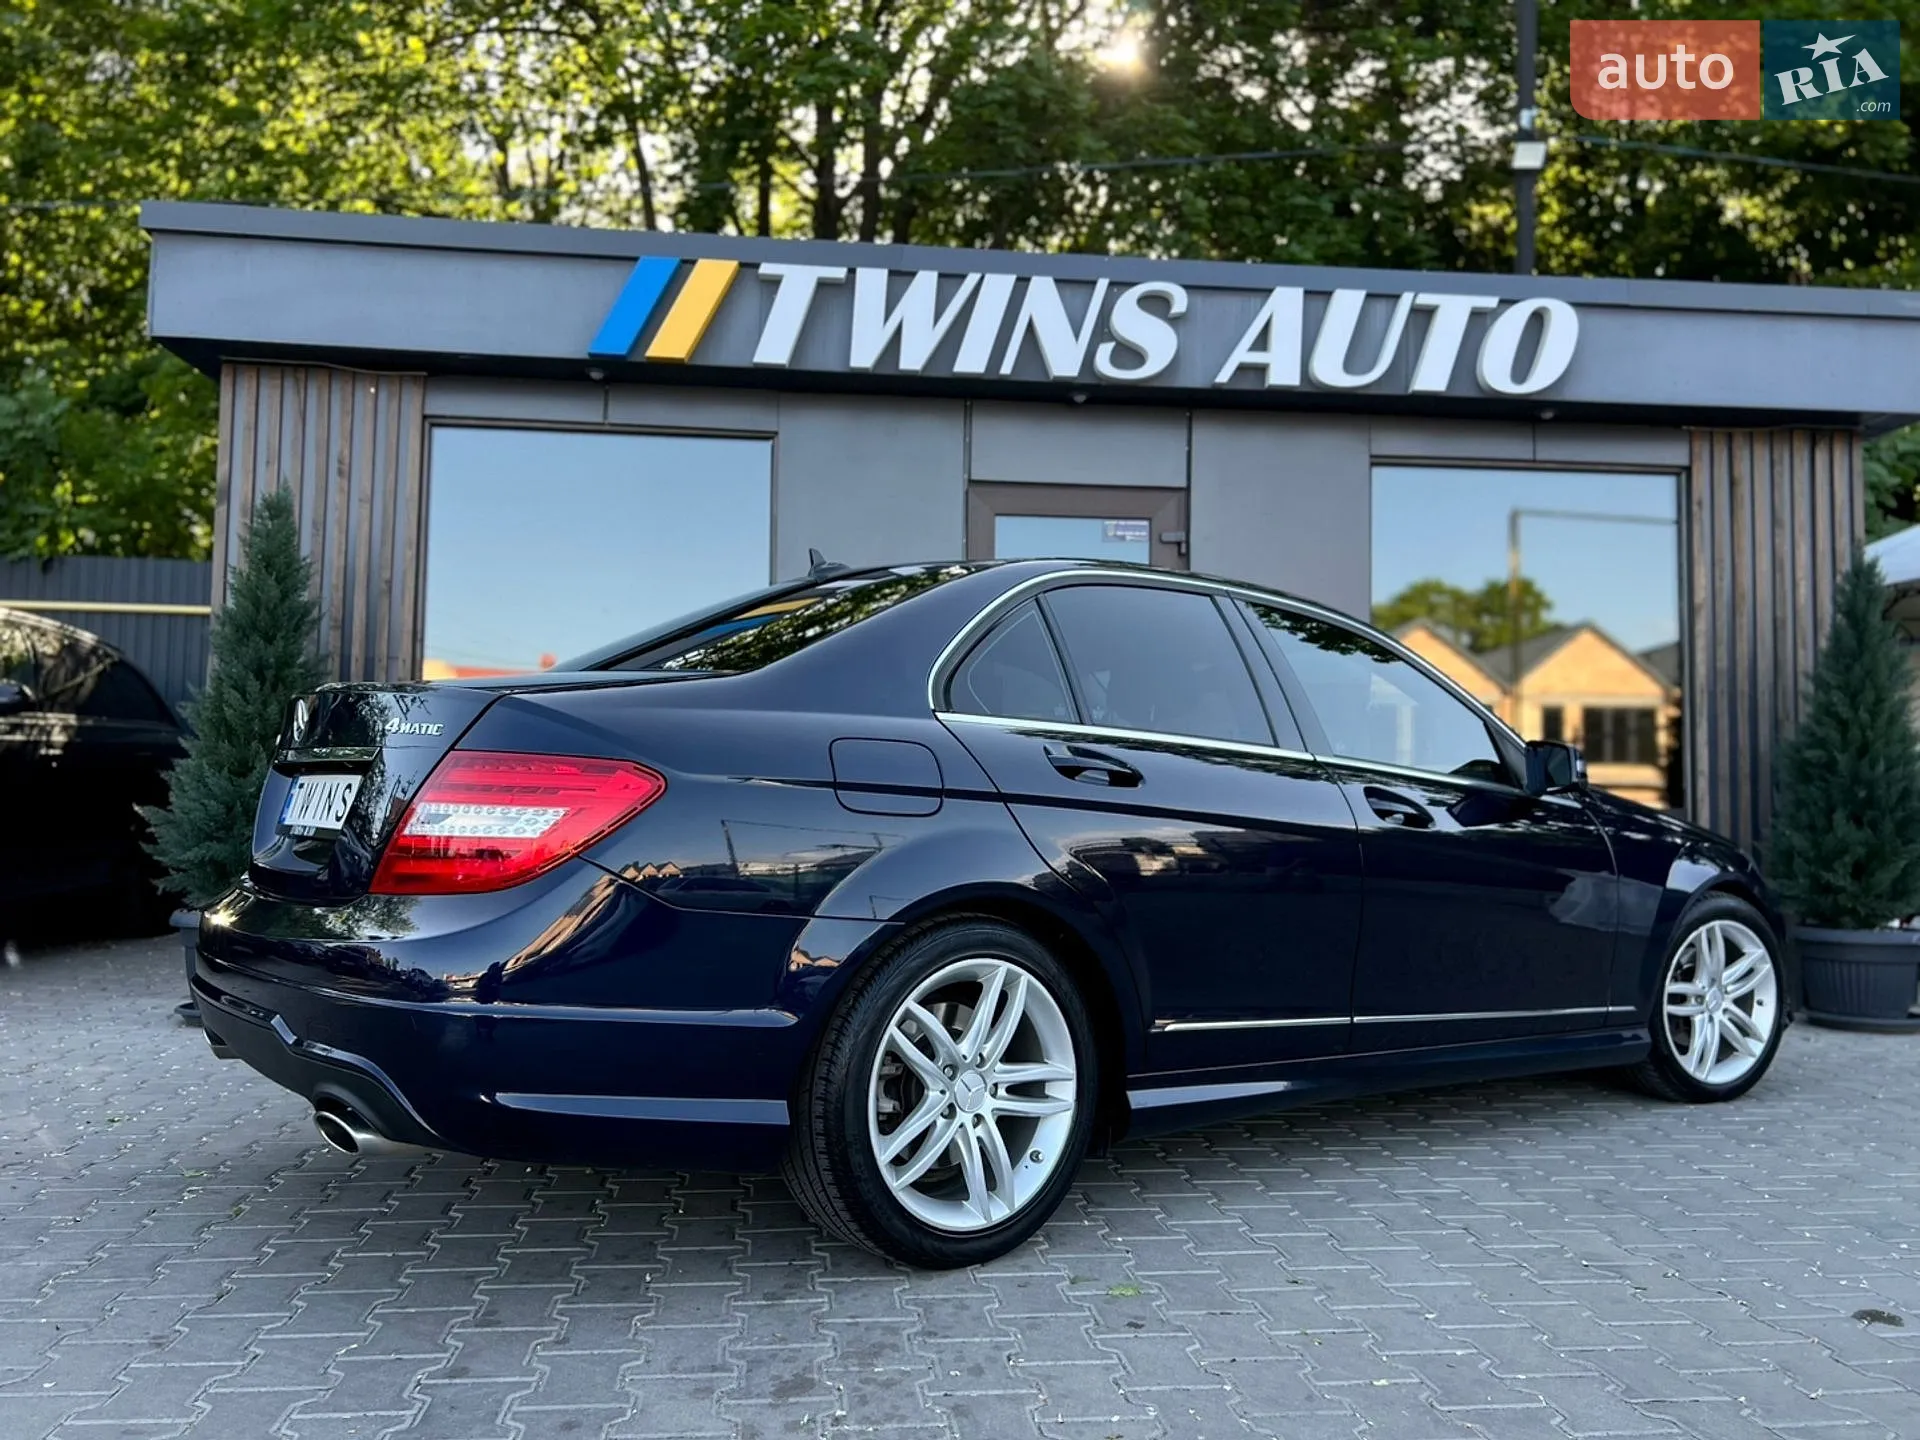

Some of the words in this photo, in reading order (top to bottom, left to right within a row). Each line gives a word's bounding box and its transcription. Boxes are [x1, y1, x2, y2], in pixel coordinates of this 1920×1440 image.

[752, 262, 1189, 382] TWINS
[1213, 286, 1579, 395] AUTO
[384, 717, 445, 736] 4MATIC
[289, 782, 353, 823] TWINS
